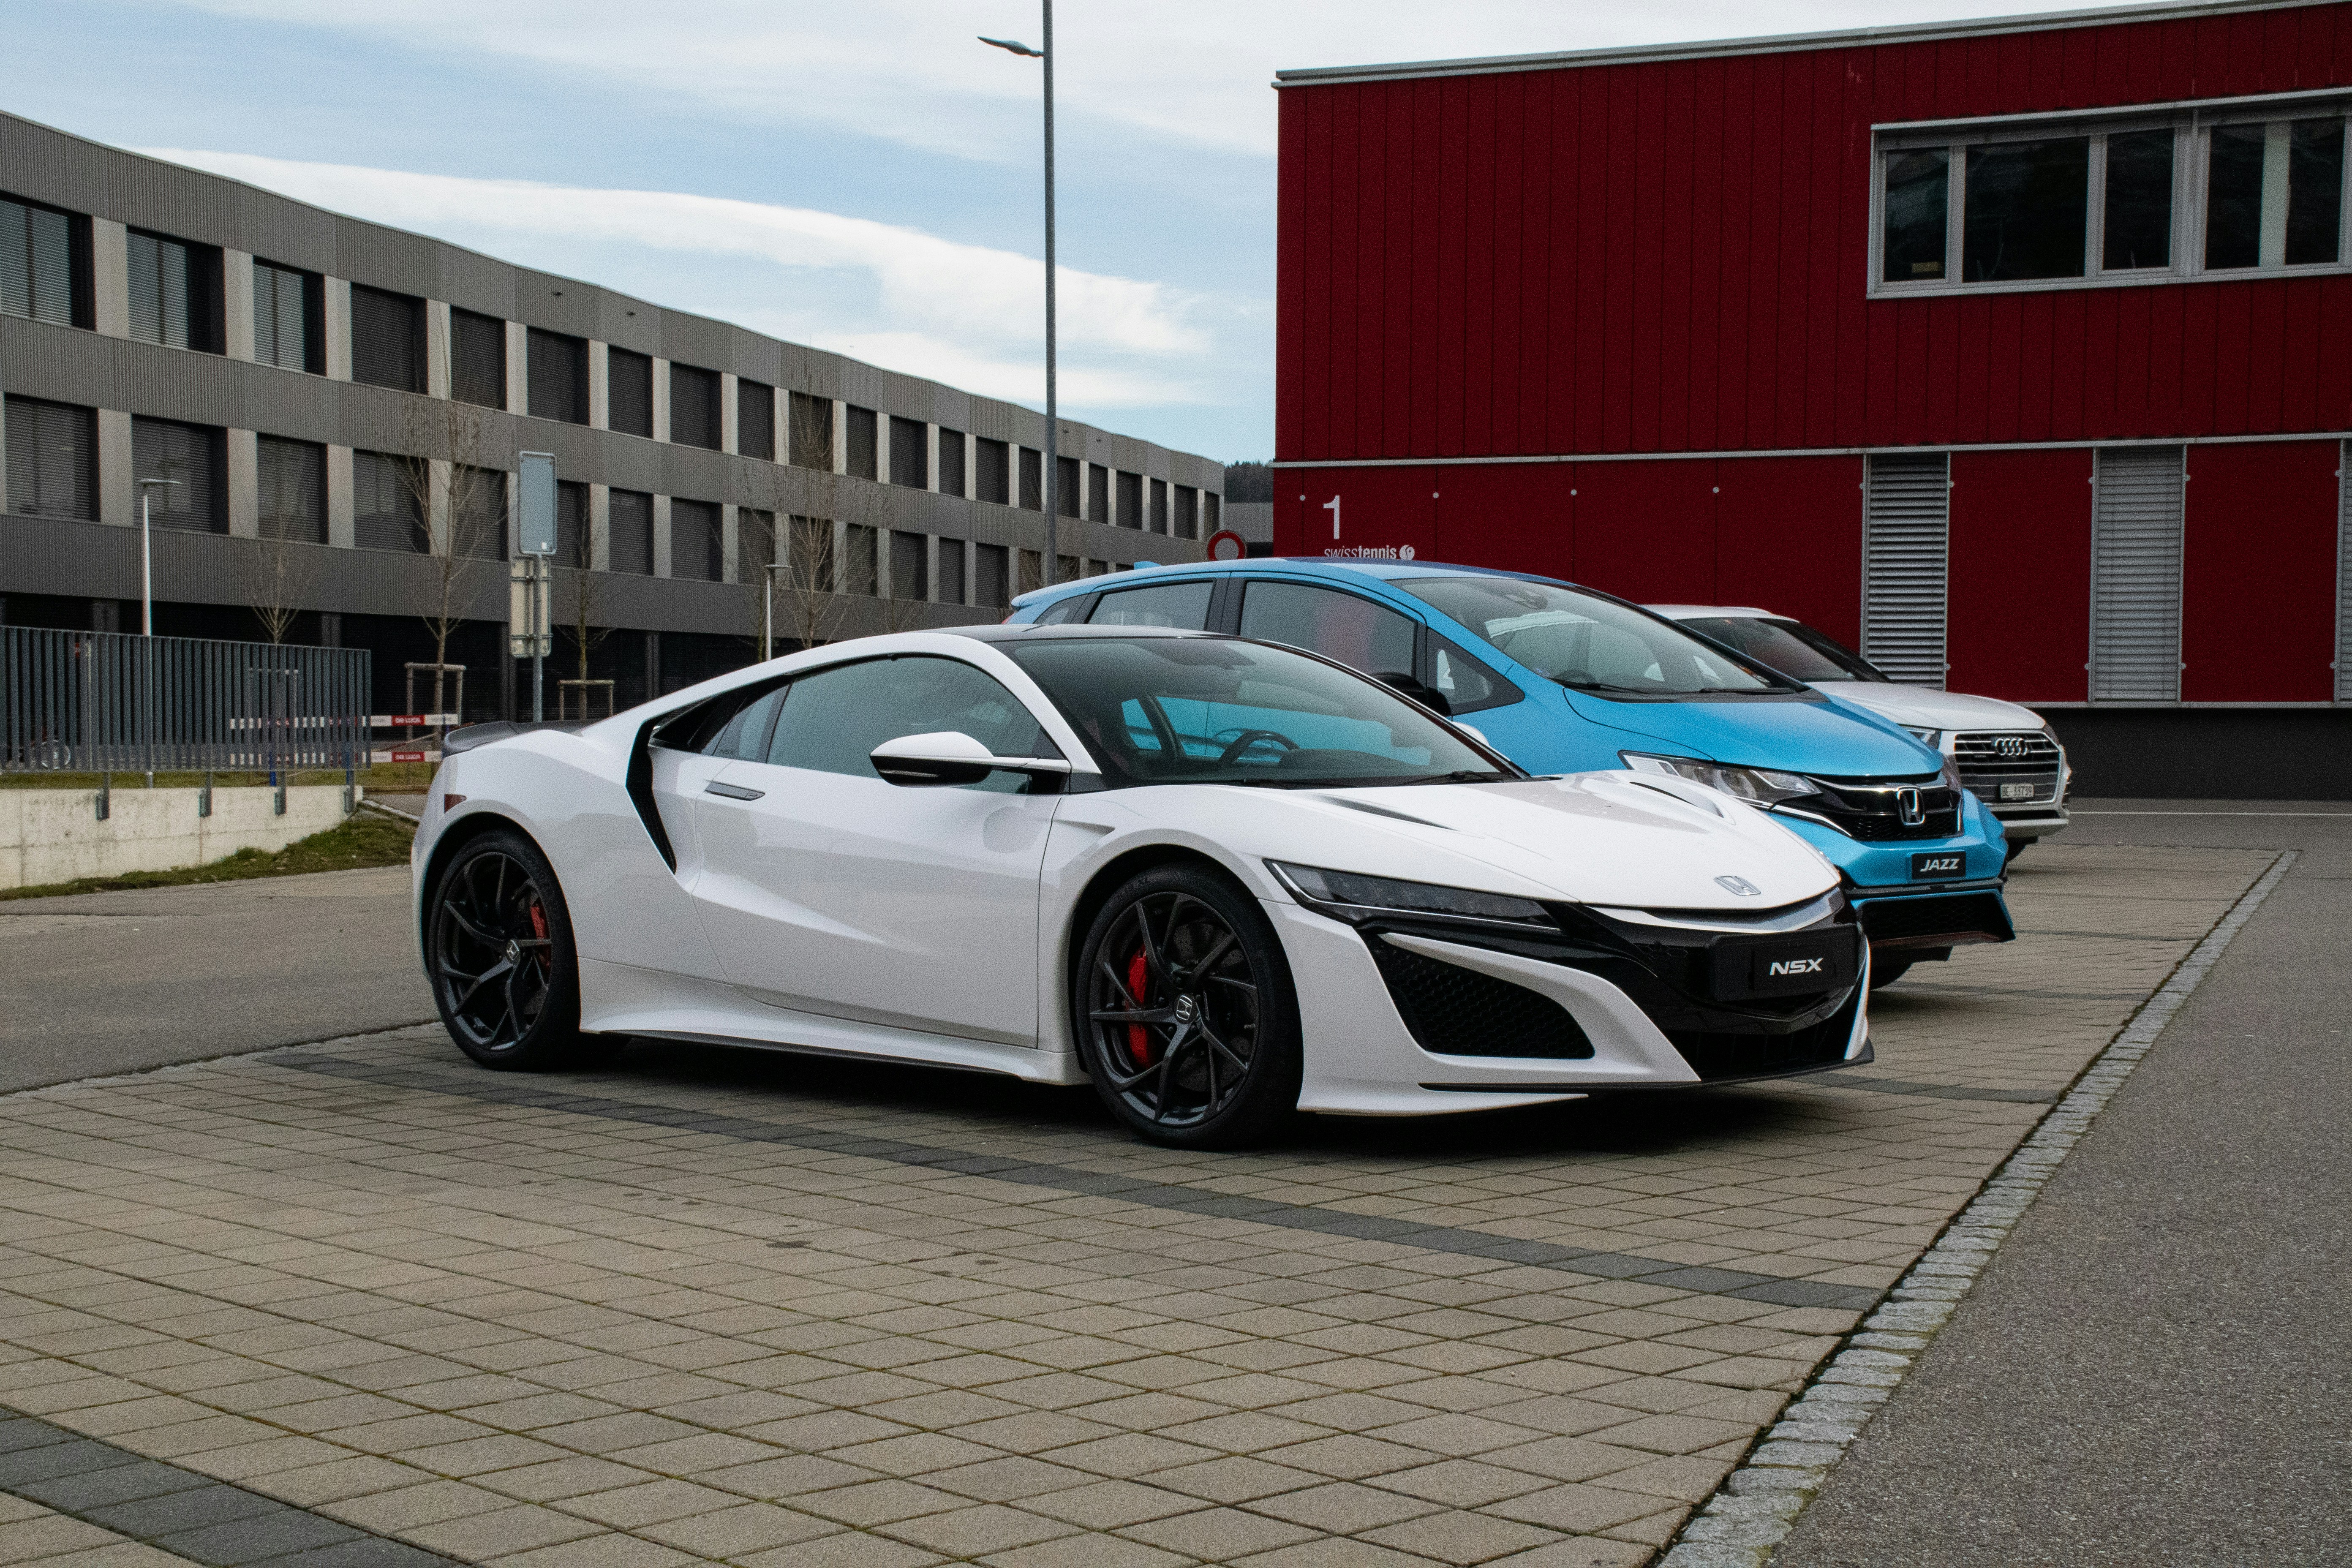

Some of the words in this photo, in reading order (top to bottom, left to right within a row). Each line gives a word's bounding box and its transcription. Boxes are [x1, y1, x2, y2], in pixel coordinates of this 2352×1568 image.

[1323, 495, 1340, 540] 1
[1324, 544, 1397, 560] swisstennis
[1919, 858, 1960, 872] JAZZ
[1769, 957, 1824, 976] NSX
